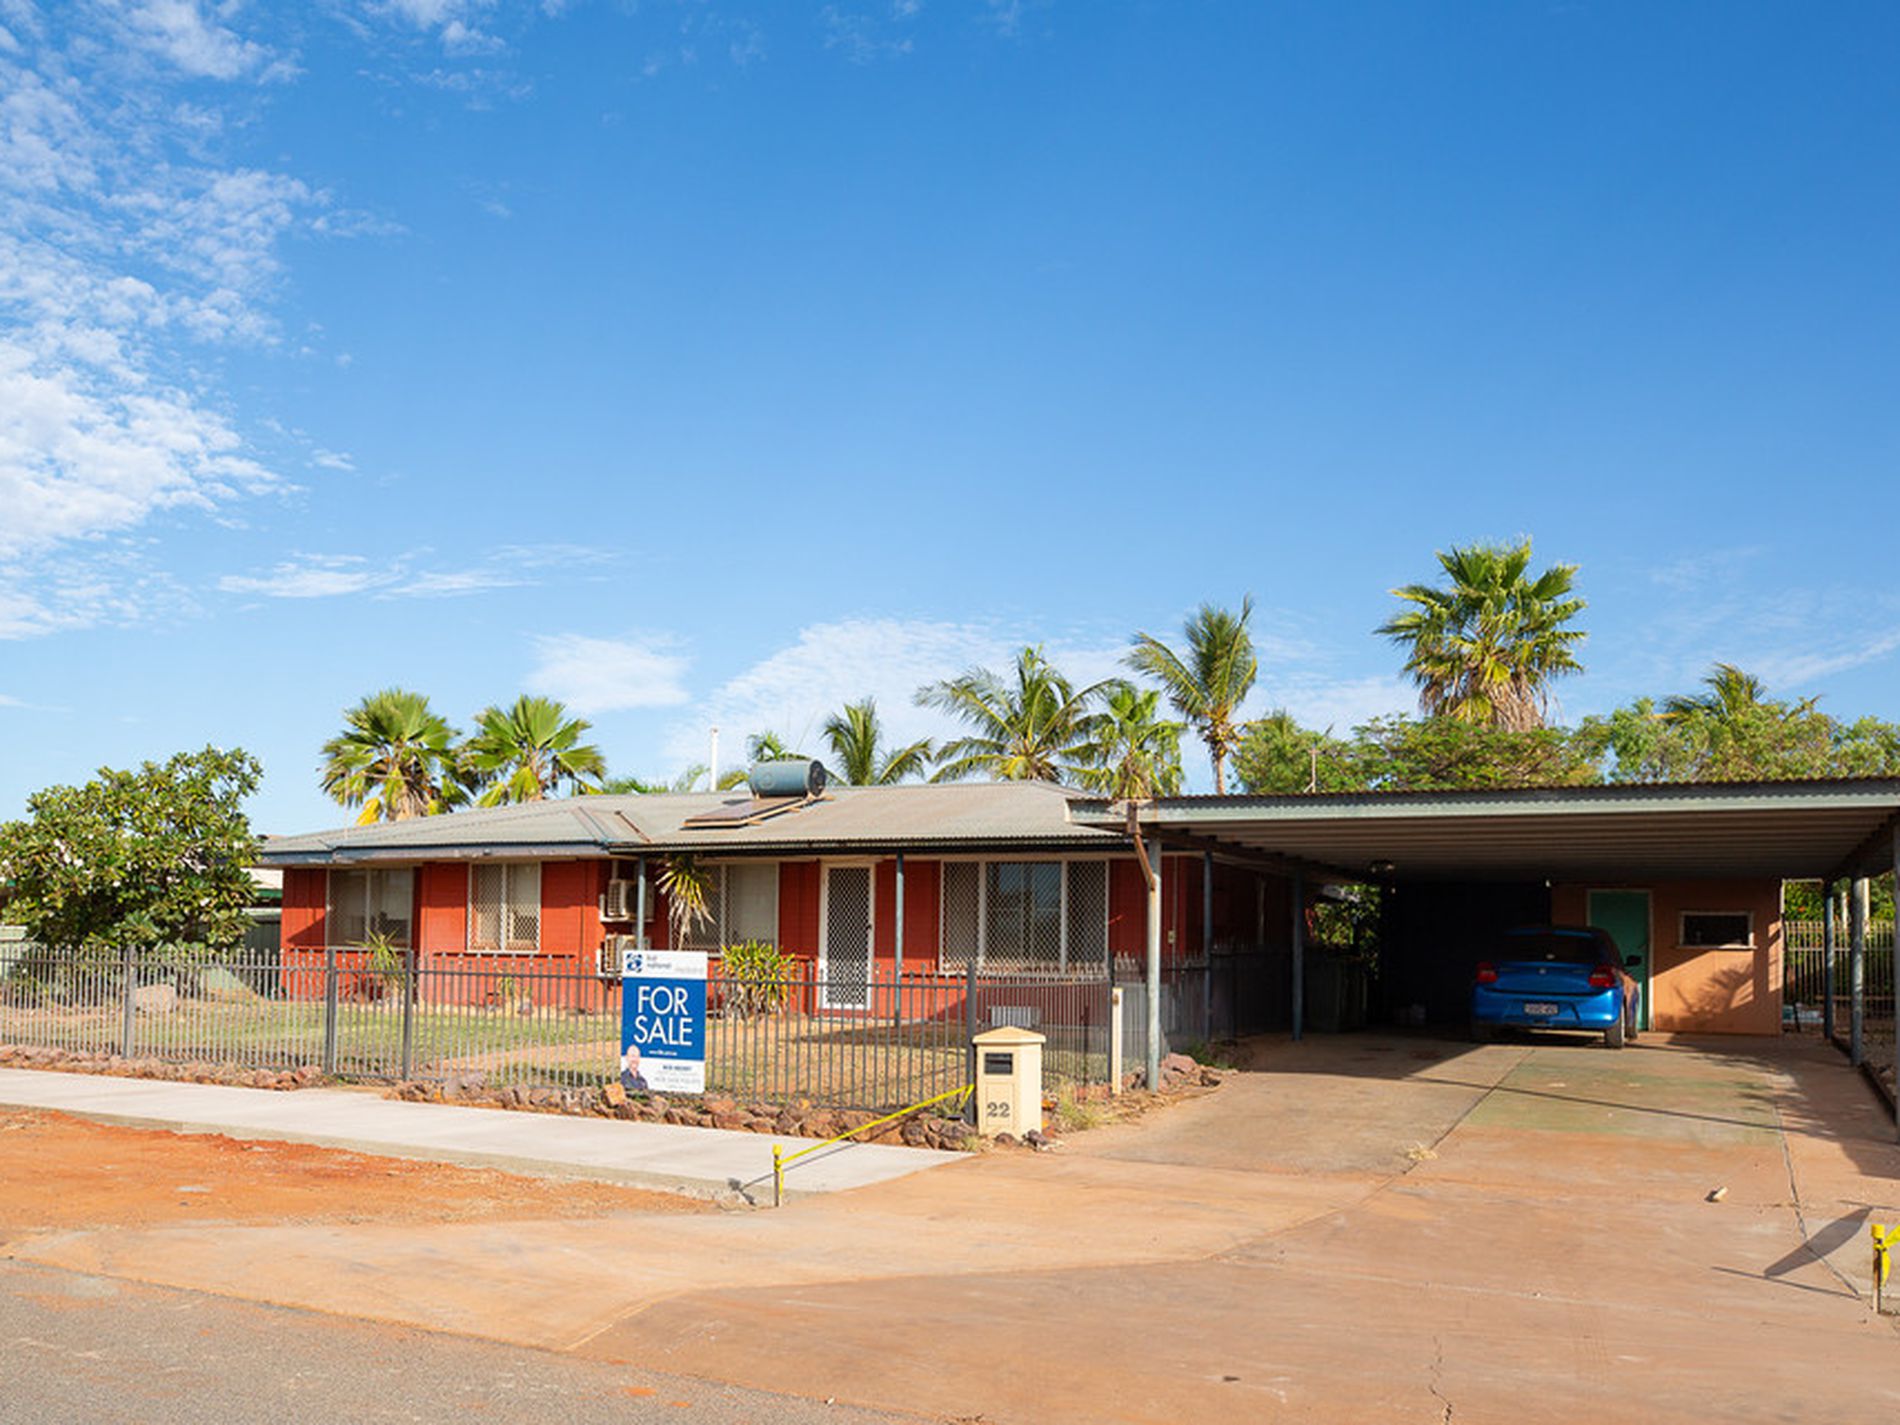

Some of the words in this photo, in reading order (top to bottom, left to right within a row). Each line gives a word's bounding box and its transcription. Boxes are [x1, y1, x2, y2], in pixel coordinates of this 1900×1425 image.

[638, 986, 688, 1015] FOR
[634, 1015, 693, 1046] SALE
[987, 1102, 1010, 1118] 22
